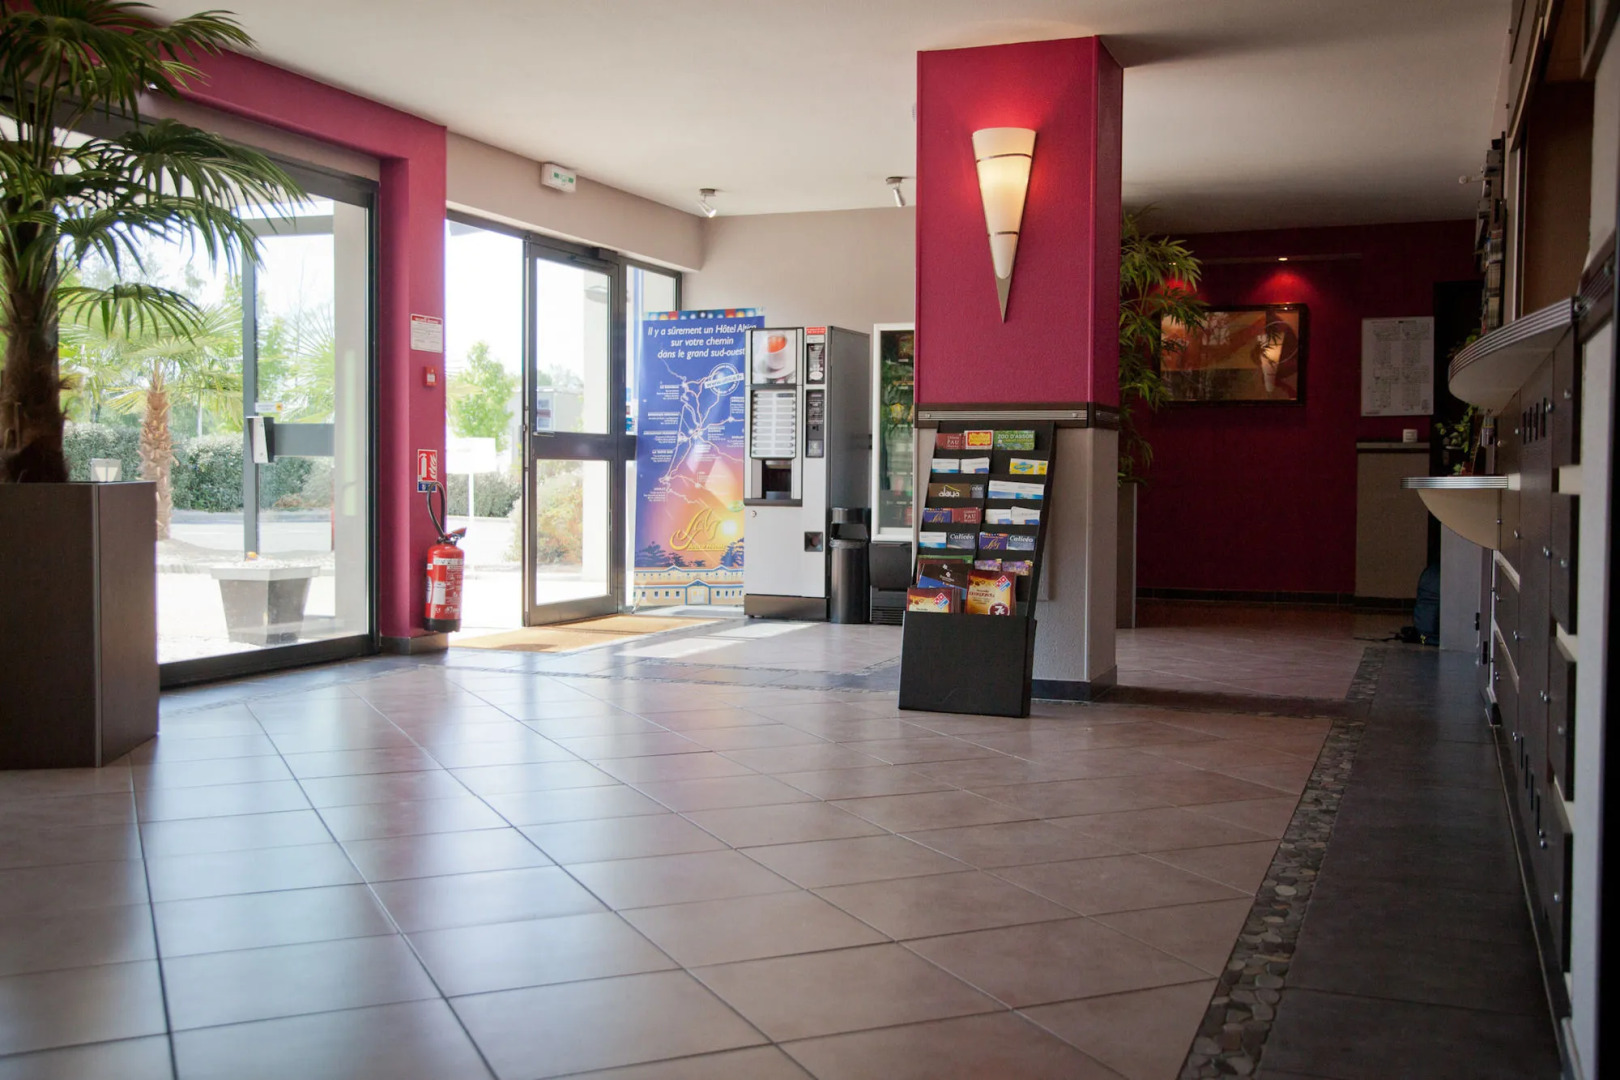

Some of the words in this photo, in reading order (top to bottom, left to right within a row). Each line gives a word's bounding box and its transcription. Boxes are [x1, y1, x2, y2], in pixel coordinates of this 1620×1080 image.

[648, 327, 653, 336] Il
[654, 330, 659, 338] y
[667, 326, 702, 335] sûrement
[715, 324, 736, 334] Hôtel
[685, 338, 704, 347] votre
[706, 337, 734, 346] chemin
[657, 349, 676, 359] dans
[677, 349, 685, 358] le
[686, 348, 709, 360] grand
[710, 347, 745, 357] sud-ouest
